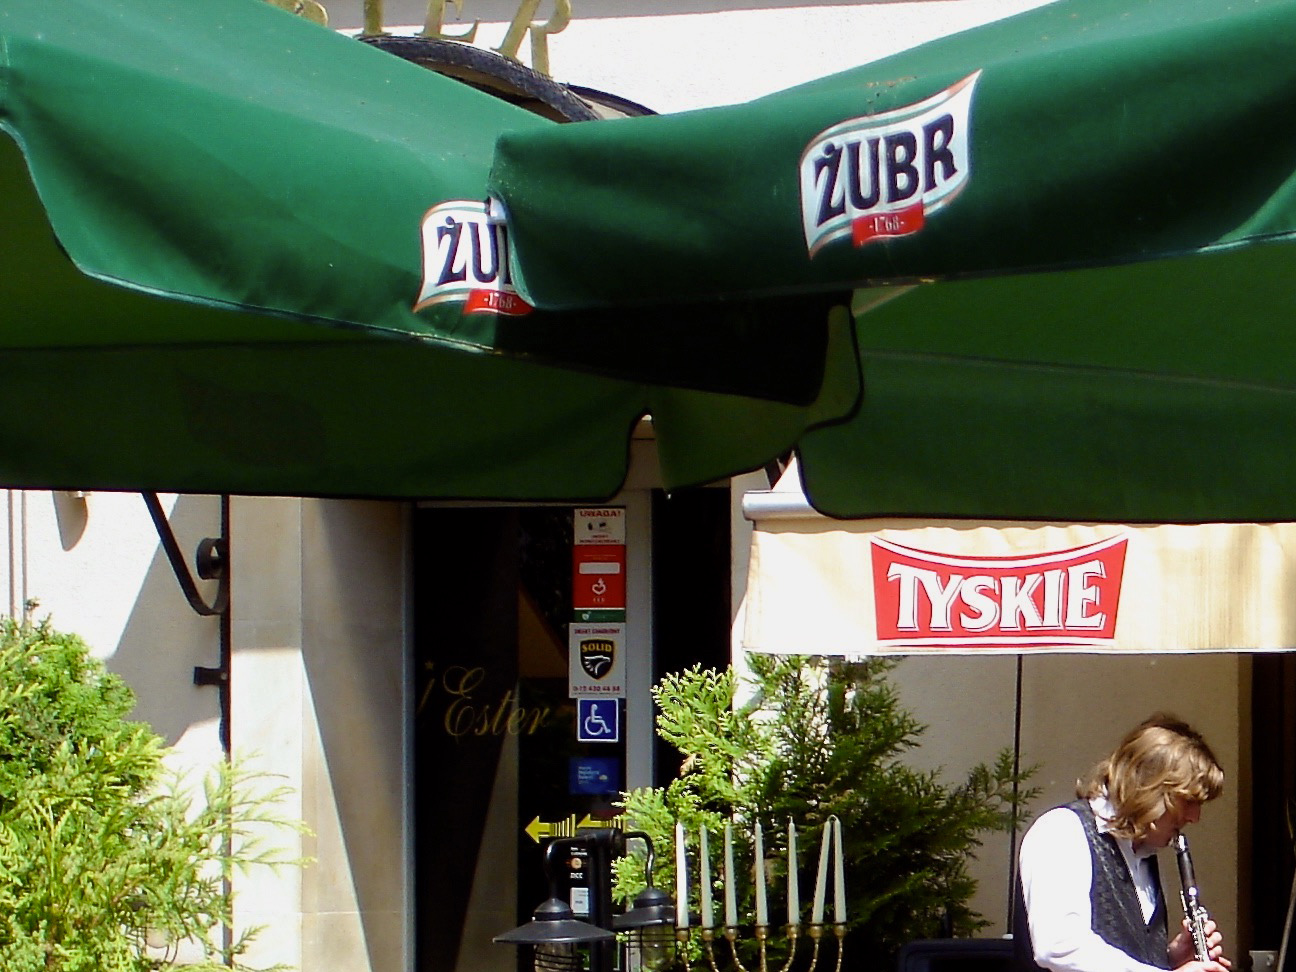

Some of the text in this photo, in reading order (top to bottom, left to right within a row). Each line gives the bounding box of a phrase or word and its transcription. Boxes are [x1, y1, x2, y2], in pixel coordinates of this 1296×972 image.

[813, 113, 958, 228] ŻUBR
[436, 215, 512, 286] ŻU
[887, 559, 1107, 632] TYSKIE
[581, 643, 612, 652] SOLID
[443, 666, 550, 744] Ester
